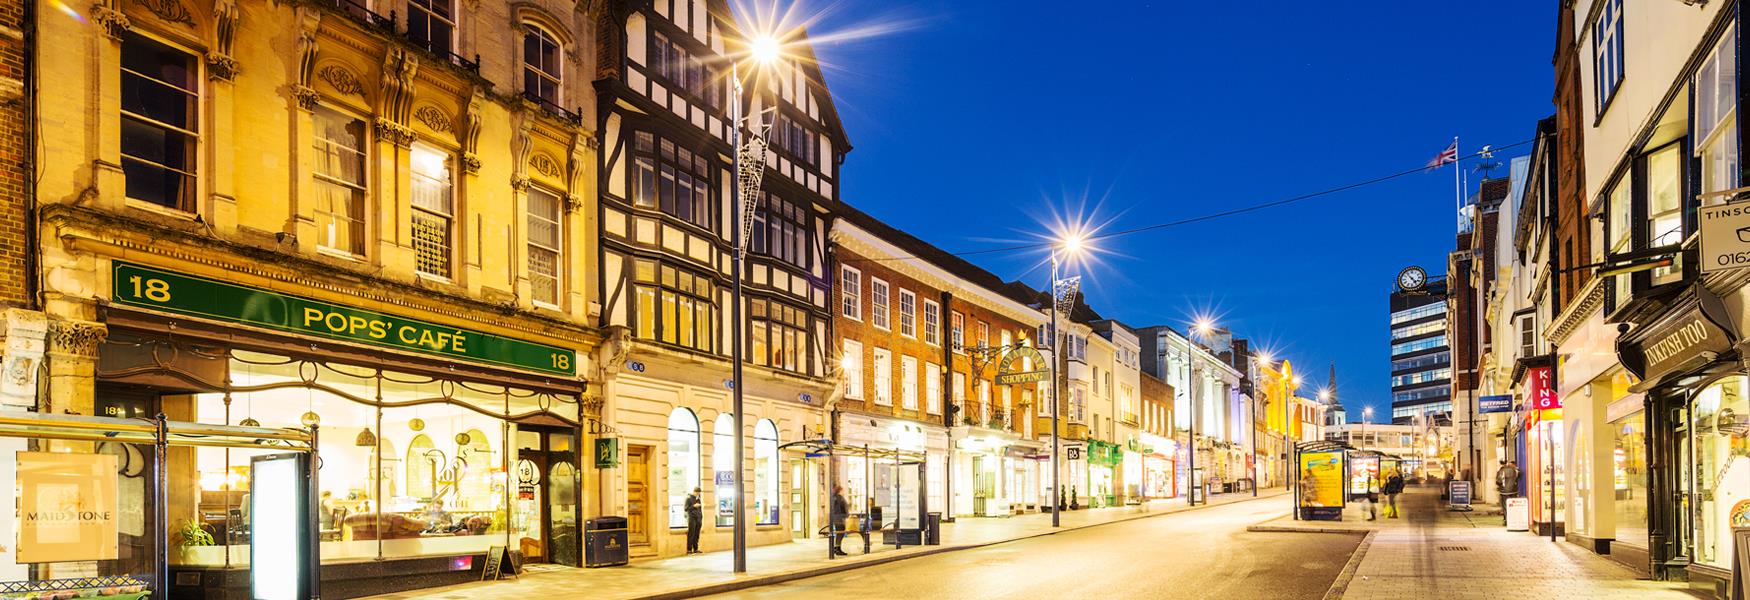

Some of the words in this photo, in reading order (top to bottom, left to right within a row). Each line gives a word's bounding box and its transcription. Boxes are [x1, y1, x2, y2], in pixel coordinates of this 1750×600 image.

[130, 275, 171, 302] 18
[399, 326, 466, 353] CAFÉ
[1644, 332, 1685, 367] INKFISH
[1680, 320, 1707, 347] TOO
[551, 352, 570, 370] 18
[1001, 373, 1043, 384] SHOPPING
[1540, 370, 1551, 407] KING
